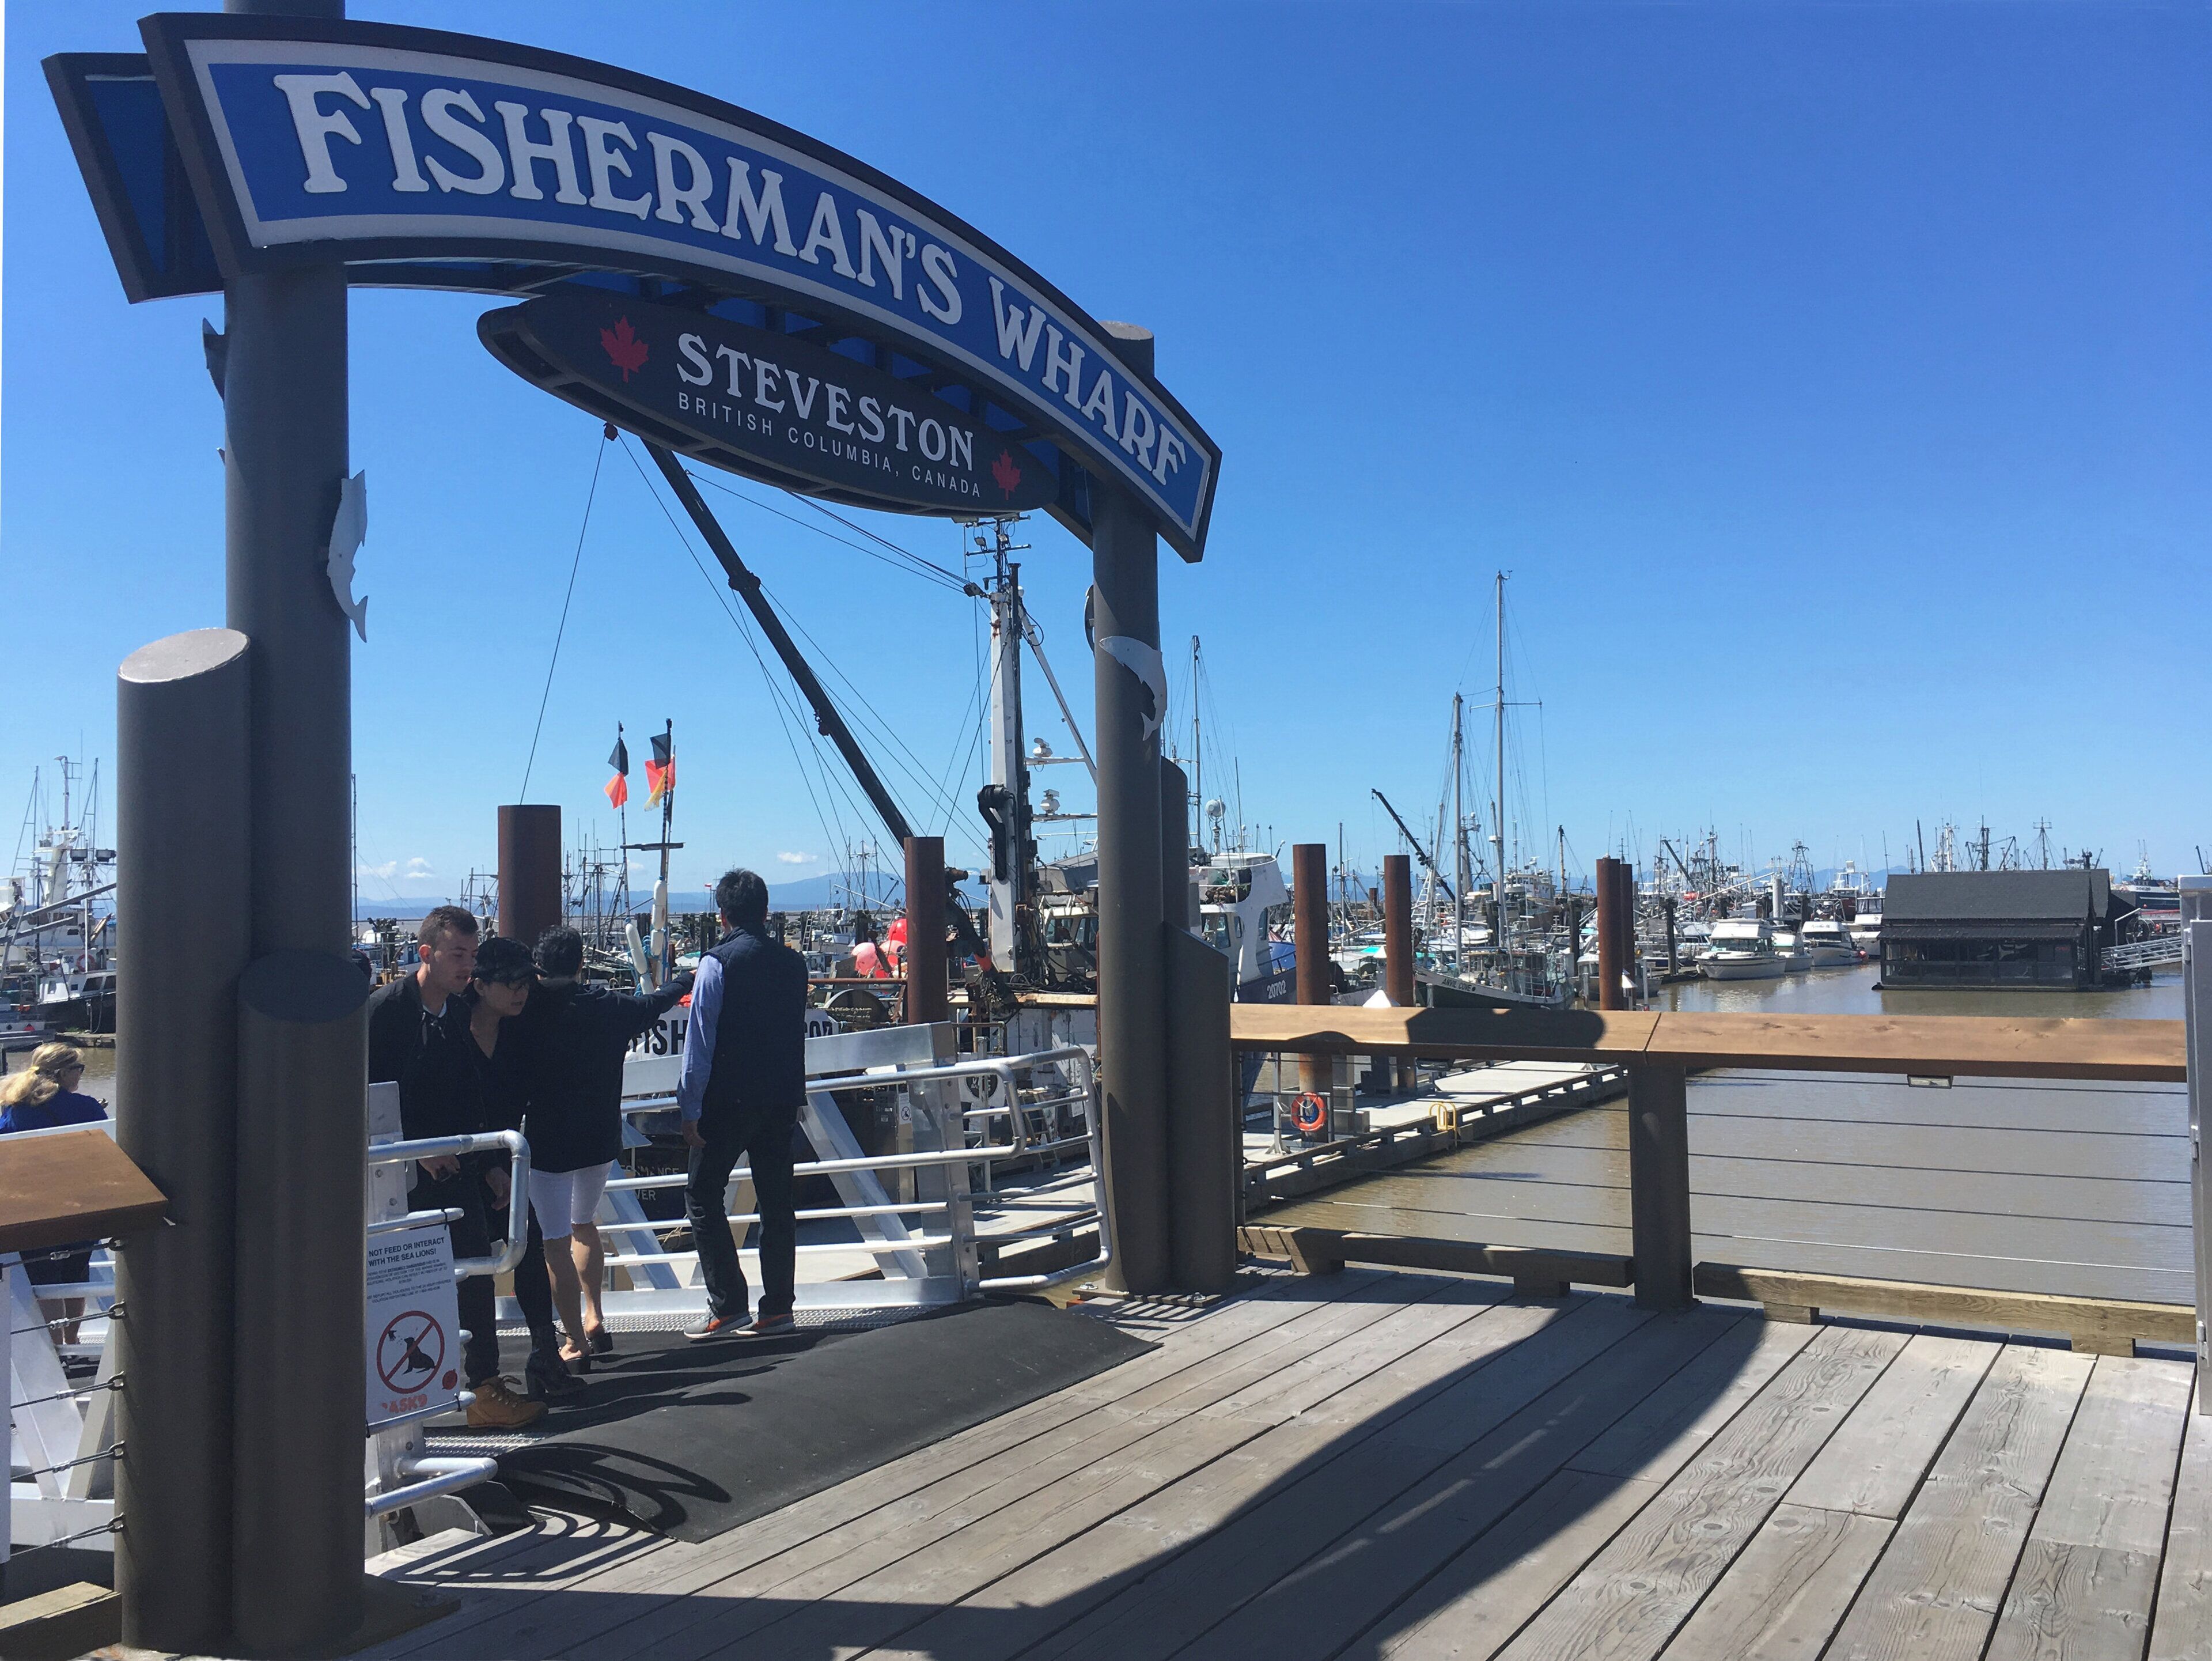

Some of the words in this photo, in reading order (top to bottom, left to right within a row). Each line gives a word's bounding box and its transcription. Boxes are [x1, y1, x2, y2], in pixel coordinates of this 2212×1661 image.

[274, 71, 963, 326] FISHERMAN'S
[988, 276, 1187, 486] WHARF
[677, 332, 974, 471] STEVESTON
[679, 392, 772, 436] BRITISH
[788, 427, 899, 478] COLUMBIA,
[912, 466, 980, 497] CANADA
[1267, 980, 1286, 999] 20702
[1441, 978, 1456, 988] ANVIL
[1459, 982, 1472, 992] COVE
[368, 1258, 385, 1266] WITH
[401, 1253, 414, 1261] SEA
[416, 1248, 437, 1258] LIONS!
[369, 1248, 382, 1257] NOT
[384, 1246, 402, 1254] FEED
[414, 1237, 444, 1249] INTERACT
